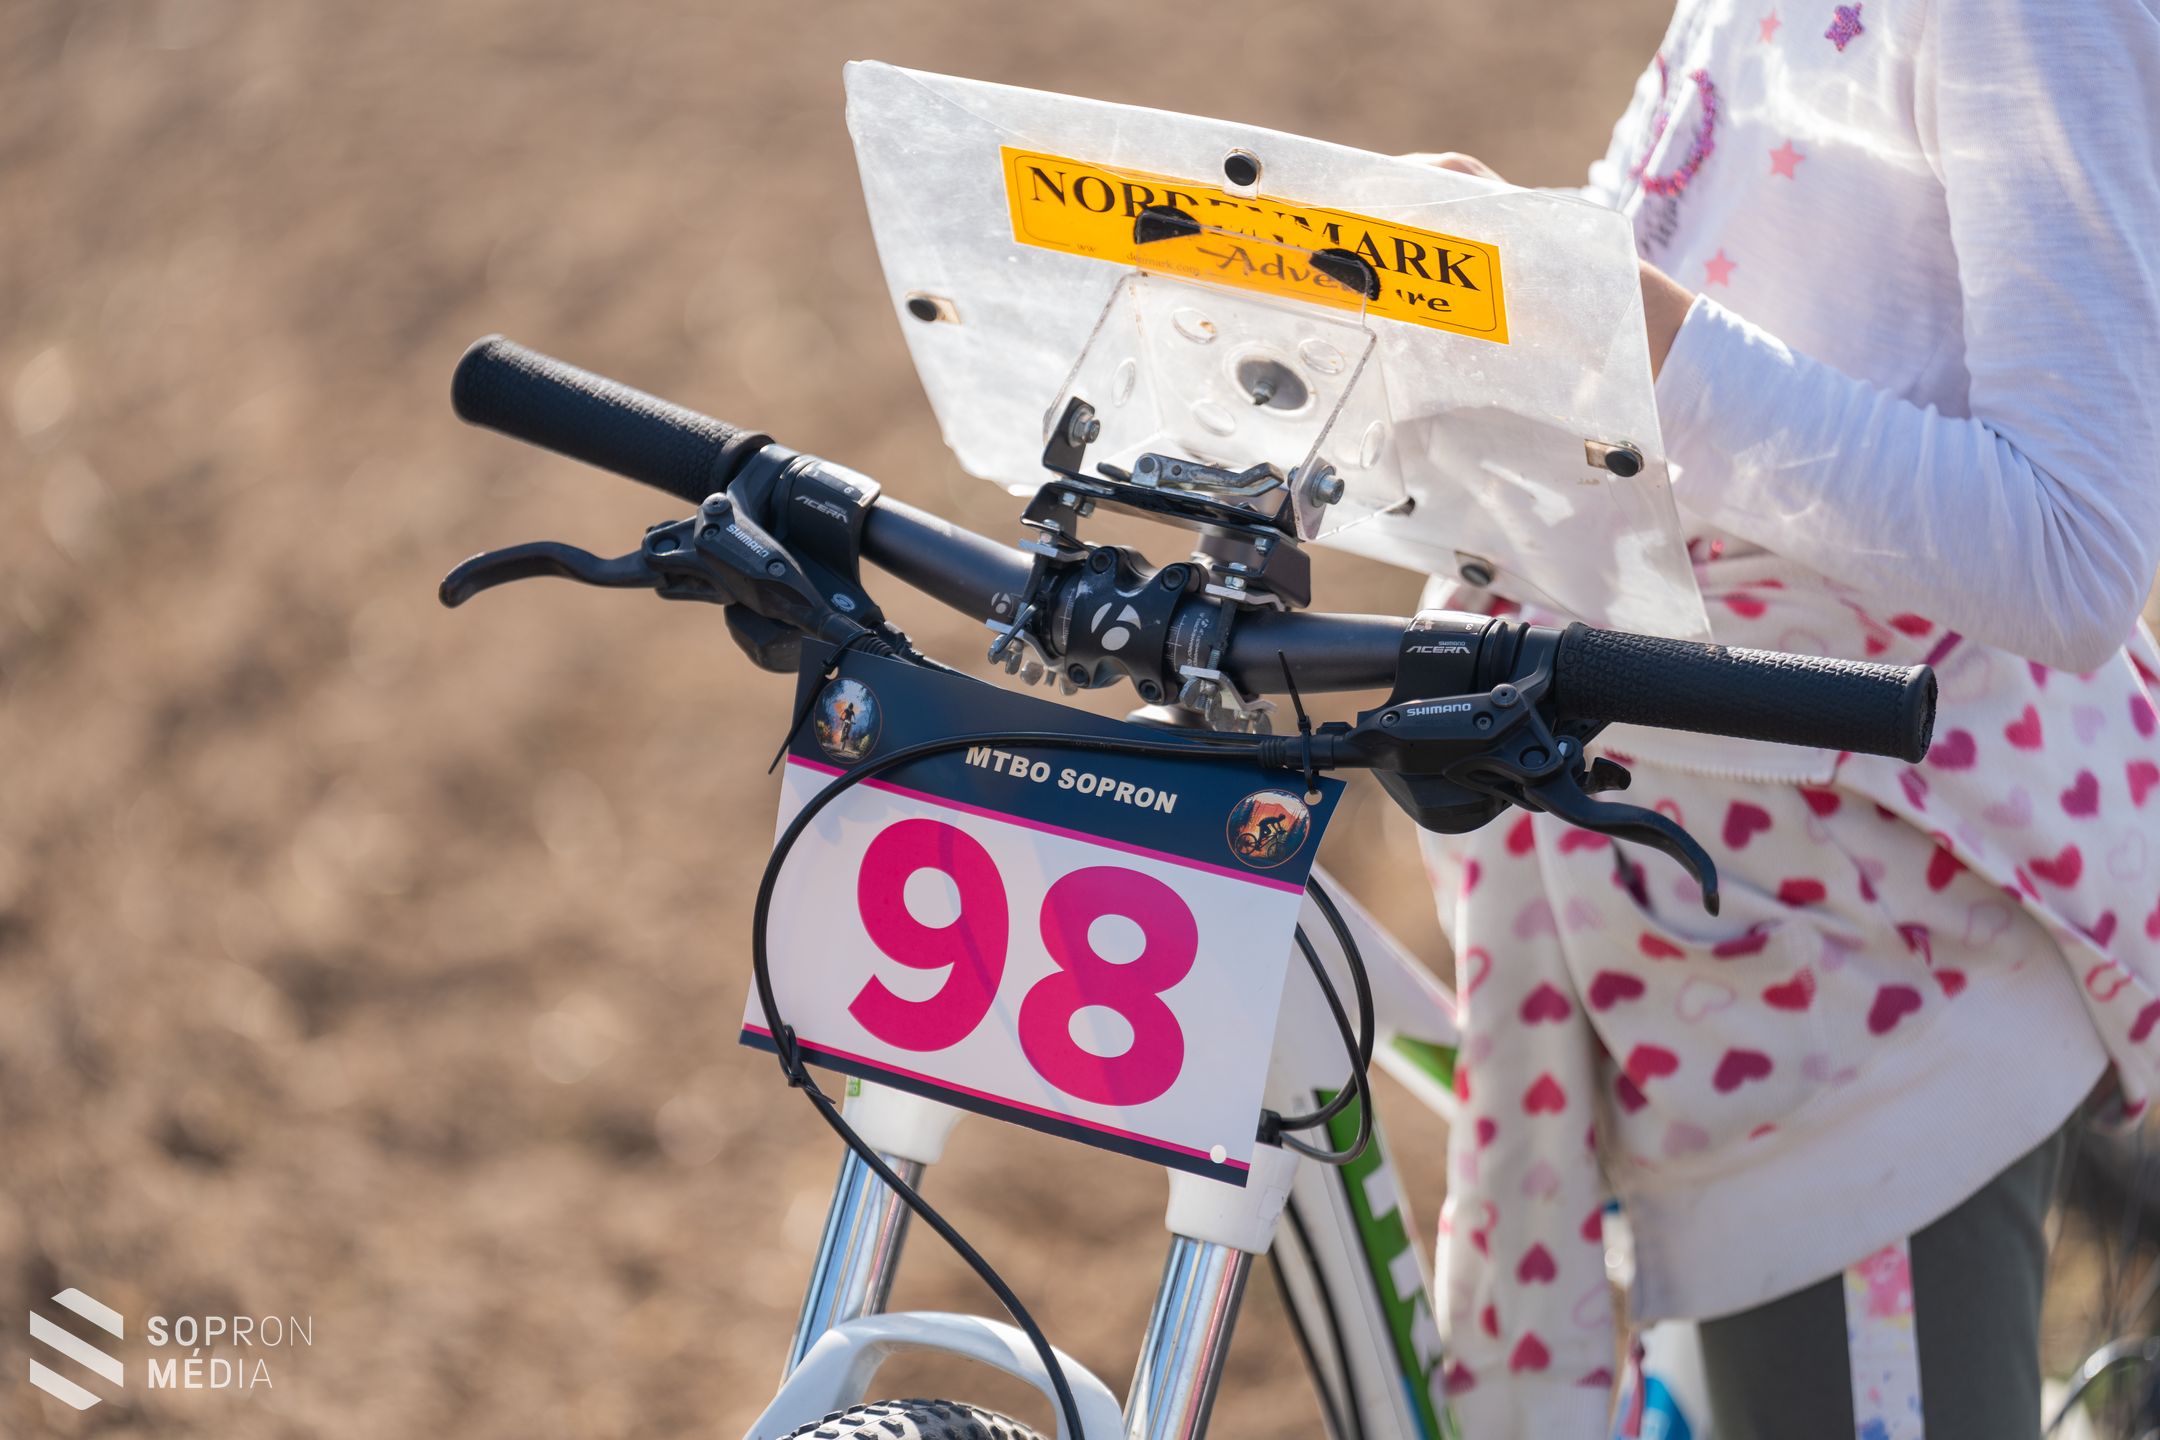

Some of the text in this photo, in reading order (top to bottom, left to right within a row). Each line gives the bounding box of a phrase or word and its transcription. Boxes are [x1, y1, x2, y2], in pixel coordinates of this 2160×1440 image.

[795, 495, 848, 524] ACERA
[725, 523, 770, 559] SHIMANO
[1406, 645, 1471, 654] ACERA
[1406, 703, 1472, 717] SHIMANO
[964, 746, 1178, 815] MTBO SOPRON
[847, 817, 1199, 1107] 98
